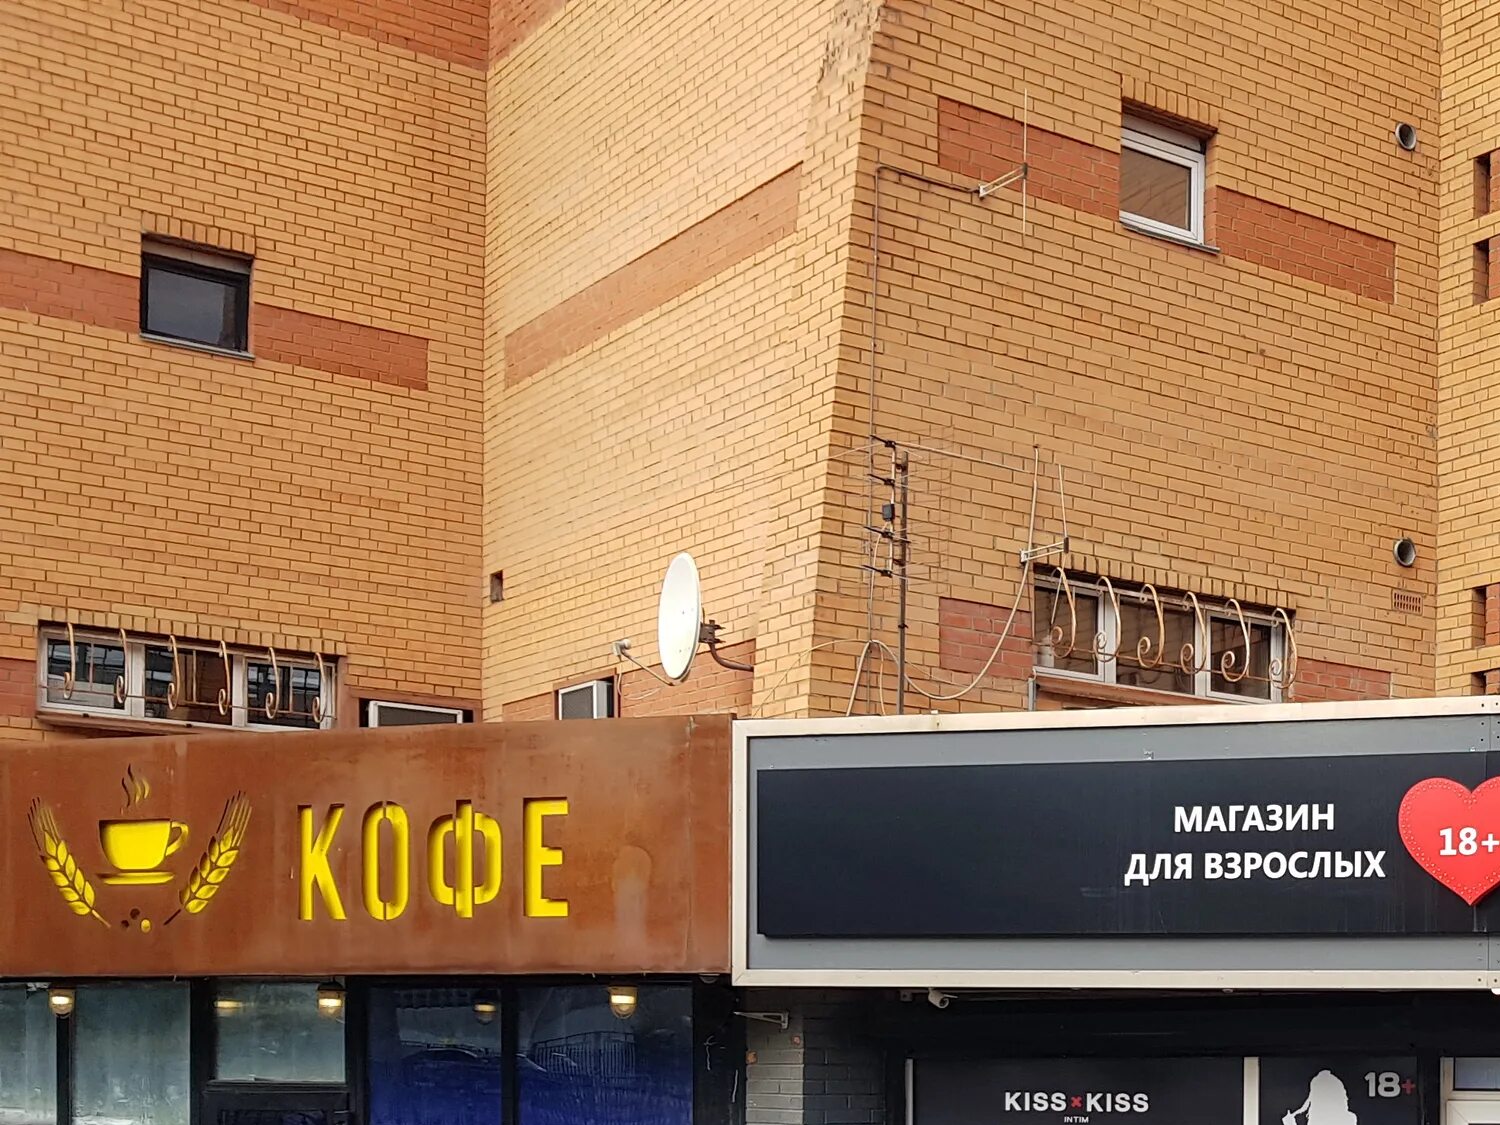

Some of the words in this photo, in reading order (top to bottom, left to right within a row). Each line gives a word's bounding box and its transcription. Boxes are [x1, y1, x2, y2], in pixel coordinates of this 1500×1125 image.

[1174, 804, 1335, 833] МАГАЗИН
[1439, 827, 1500, 856] 18+
[297, 797, 569, 920] КОФЕ
[1124, 853, 1193, 886] ДЛЯ
[1204, 850, 1387, 880] ВЗРОСЛЫХ
[1364, 1071, 1416, 1097] 18+
